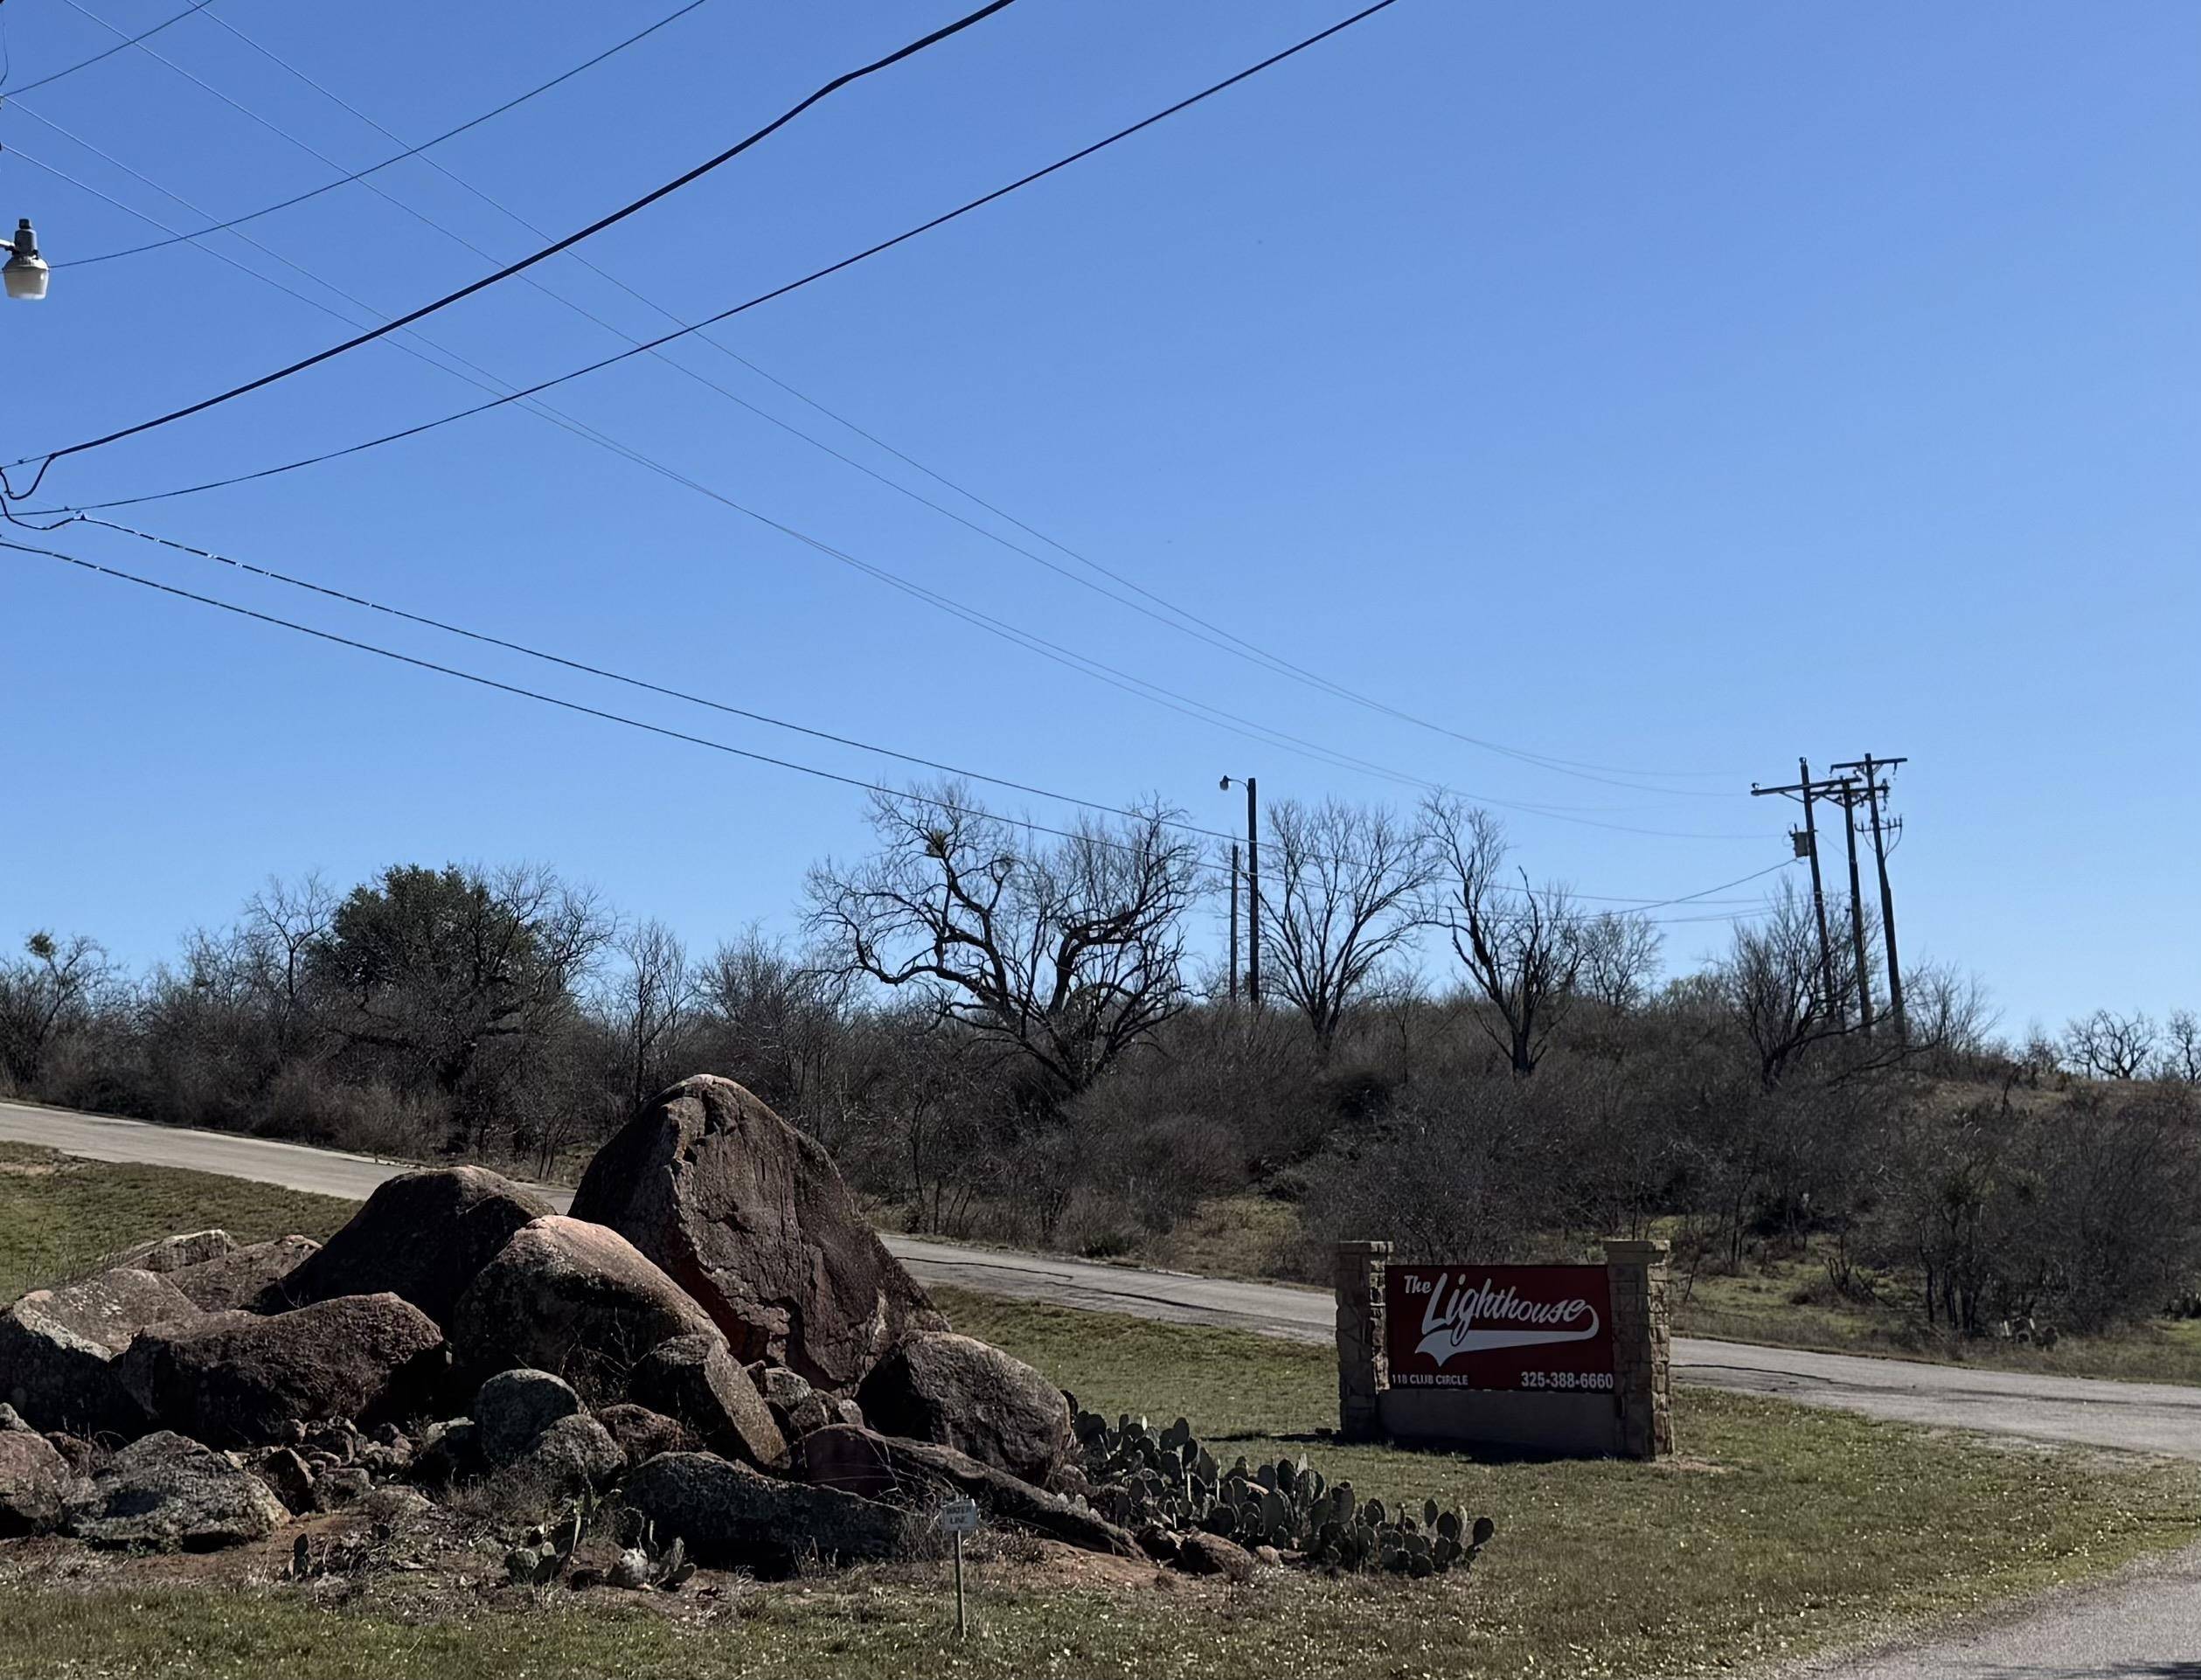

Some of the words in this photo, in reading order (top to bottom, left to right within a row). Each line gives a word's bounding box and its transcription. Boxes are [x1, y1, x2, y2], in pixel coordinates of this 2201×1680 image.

[1404, 1274, 1432, 1294] The
[1421, 1273, 1587, 1345] Lighthouse
[1409, 1374, 1434, 1385] CLUB
[1435, 1374, 1468, 1385] CIRCLE
[1521, 1371, 1614, 1389] 325-388-6660
